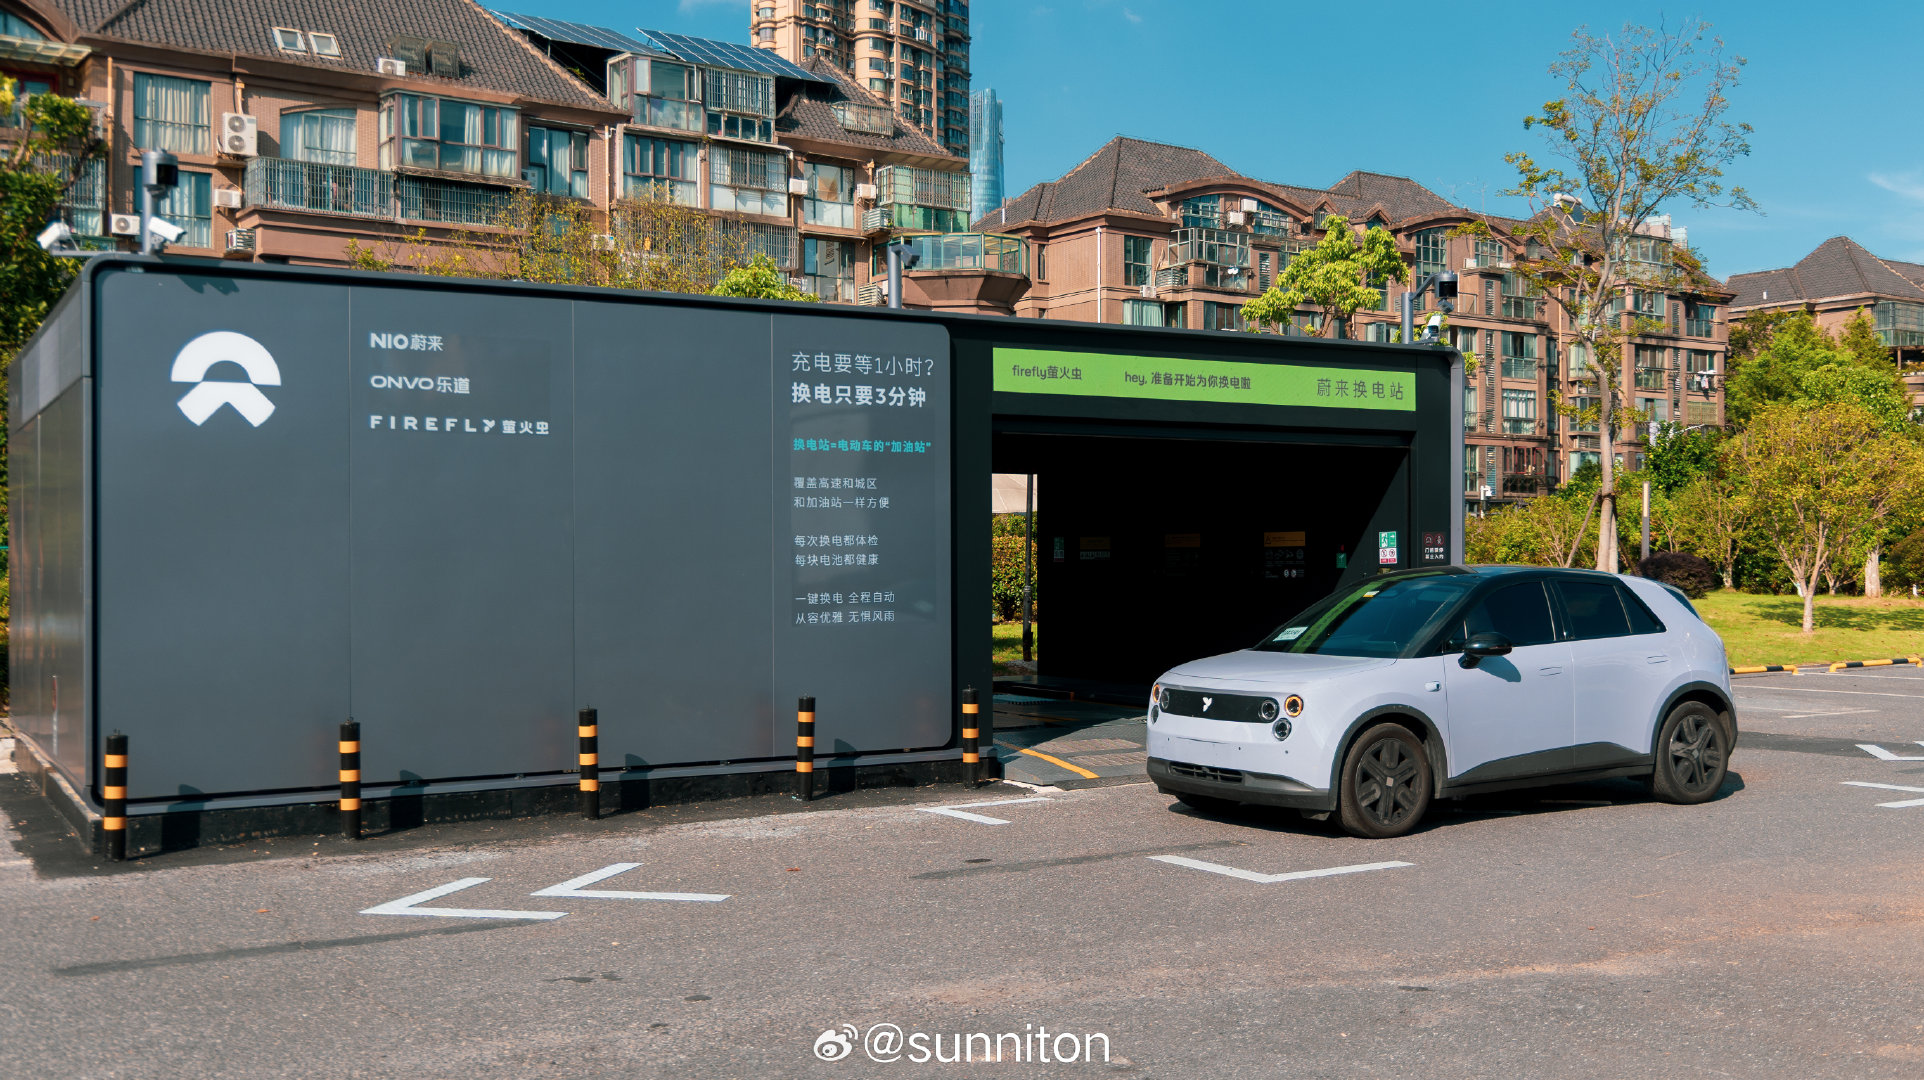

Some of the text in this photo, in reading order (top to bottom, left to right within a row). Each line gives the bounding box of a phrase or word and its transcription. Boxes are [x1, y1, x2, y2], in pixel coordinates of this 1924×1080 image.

[370, 332, 444, 352] NIO 蔚来
[371, 375, 471, 395] ONVO 乐道
[1125, 371, 1252, 390] hey, 准备开始为你换电啦
[792, 382, 926, 407] 换电只要3分钟
[1317, 378, 1404, 401] 蔚来换电站
[370, 415, 549, 435] FIREFLY 萤火虫
[794, 476, 878, 490] 覆盖高速和城区
[794, 496, 890, 509] 和加油站一样方便
[794, 534, 879, 547] 每次换电都体检
[795, 553, 879, 567] 每块电池都健康
[795, 591, 895, 605] 一键换电 全程自动
[796, 610, 895, 625] 从容优雅 无惧风雨
